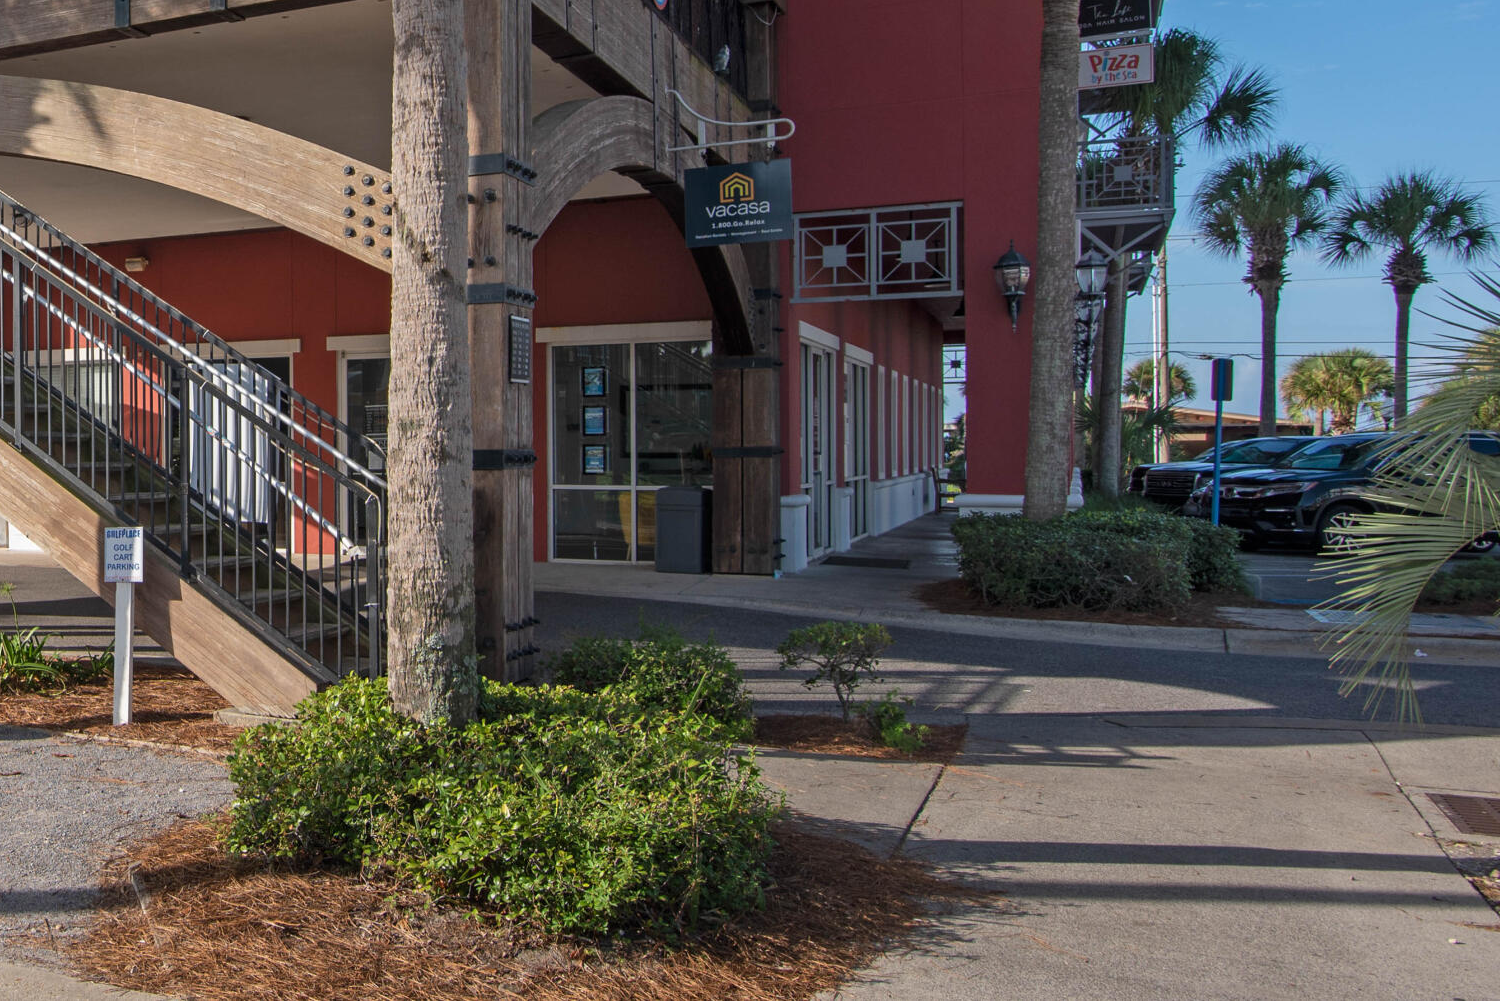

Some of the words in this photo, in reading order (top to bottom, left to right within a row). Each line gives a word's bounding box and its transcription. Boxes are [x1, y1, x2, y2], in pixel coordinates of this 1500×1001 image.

[1119, 15, 1146, 24] SALON
[1088, 51, 1140, 74] Pizza
[1091, 74, 1103, 84] by
[1104, 71, 1121, 82] the
[705, 200, 771, 219] vacasa
[113, 543, 133, 551] GOLF
[113, 553, 133, 561] CART
[107, 563, 140, 571] PARKING
